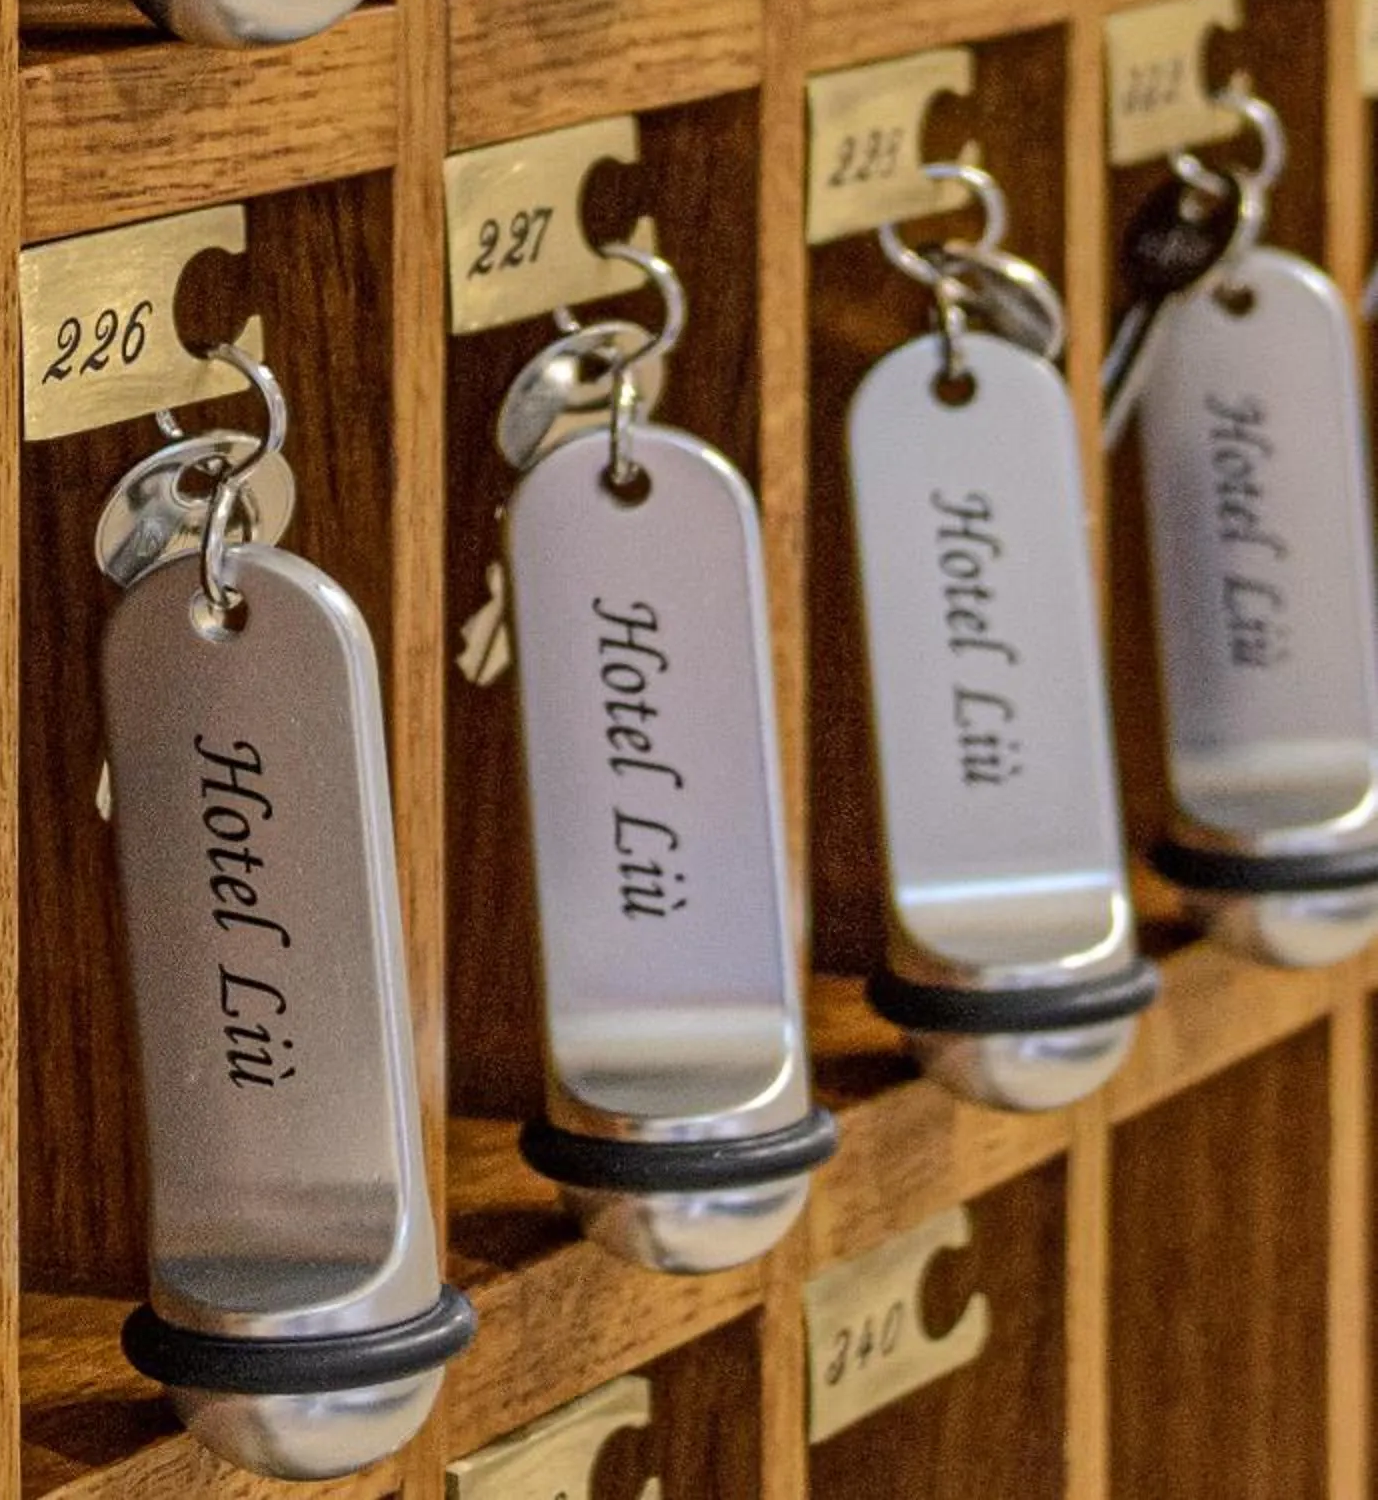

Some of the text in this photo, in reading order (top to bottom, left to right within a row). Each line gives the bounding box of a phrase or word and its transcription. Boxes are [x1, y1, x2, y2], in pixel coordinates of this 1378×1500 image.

[466, 206, 555, 277] 227
[40, 299, 155, 385] 226
[929, 489, 1021, 667] Hotel
[590, 595, 689, 920] Hotel Liù
[192, 732, 298, 1089] Hotel Liù
